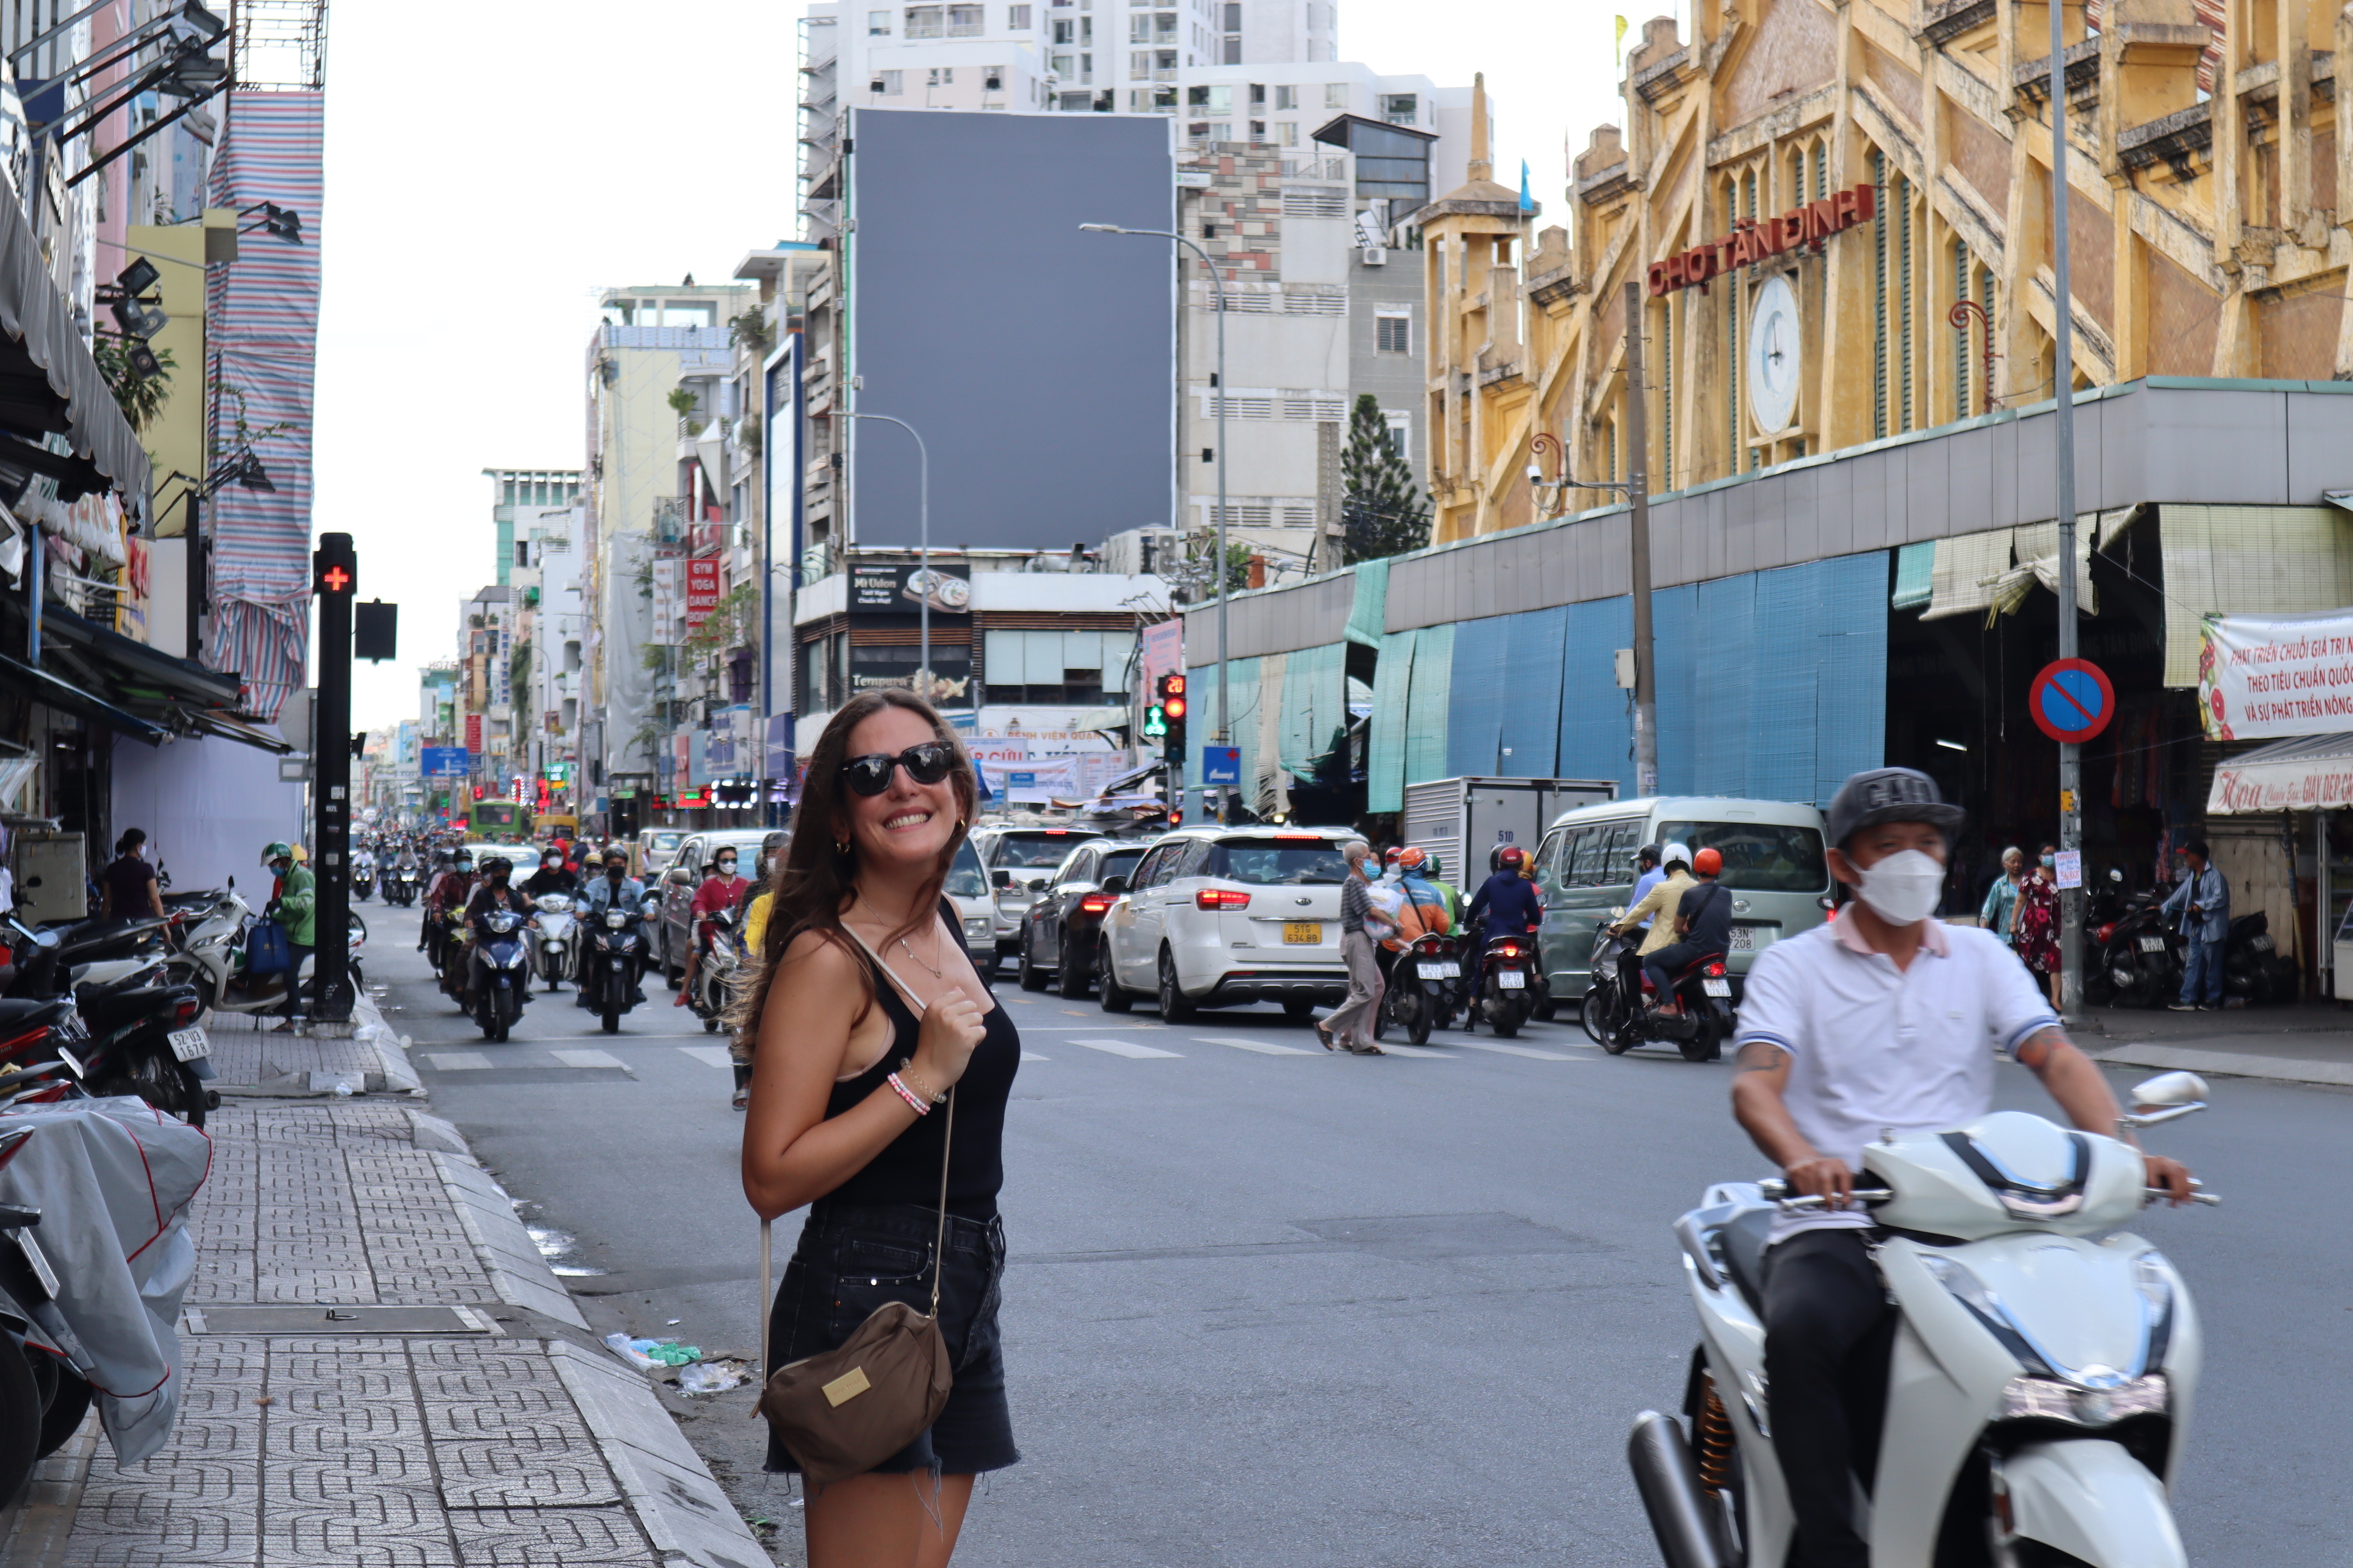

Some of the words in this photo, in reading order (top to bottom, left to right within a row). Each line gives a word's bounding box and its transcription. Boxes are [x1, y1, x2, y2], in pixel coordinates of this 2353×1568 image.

[1649, 245, 1717, 297] CHỢ
[1716, 216, 1782, 275] TÂN
[1784, 184, 1875, 253] ĐỊNH
[693, 563, 713, 575] GYM
[691, 580, 715, 590] YOGA
[869, 578, 896, 588] Udon
[689, 596, 717, 607] DANCE
[2230, 646, 2252, 666] PHÁT
[2254, 640, 2278, 665] TRIỂN
[2280, 635, 2309, 662] CHUỖI
[2311, 636, 2328, 658] GIÁ
[2331, 637, 2345, 660] TRỊ
[852, 675, 908, 688] Tempura
[2247, 675, 2269, 693] THEO
[2271, 670, 2291, 692] TIÊU
[2294, 663, 2325, 689] CHUẨN
[1168, 679, 1183, 693] 20
[2245, 702, 2258, 722] VÀ
[2258, 702, 2271, 726] SỰ
[2272, 699, 2294, 720] PHÁT
[2296, 694, 2322, 719] TRIỂN
[2324, 695, 2353, 716] NÔNG
[1041, 731, 1066, 741] VIỆN
[2215, 771, 2263, 809] Hoa
[2323, 766, 2341, 802] DÉP
[1498, 830, 1514, 842] 51D
[1288, 934, 1317, 942] 634.88
[176, 1031, 202, 1046] 52-U3
[179, 1043, 206, 1059] 1678
